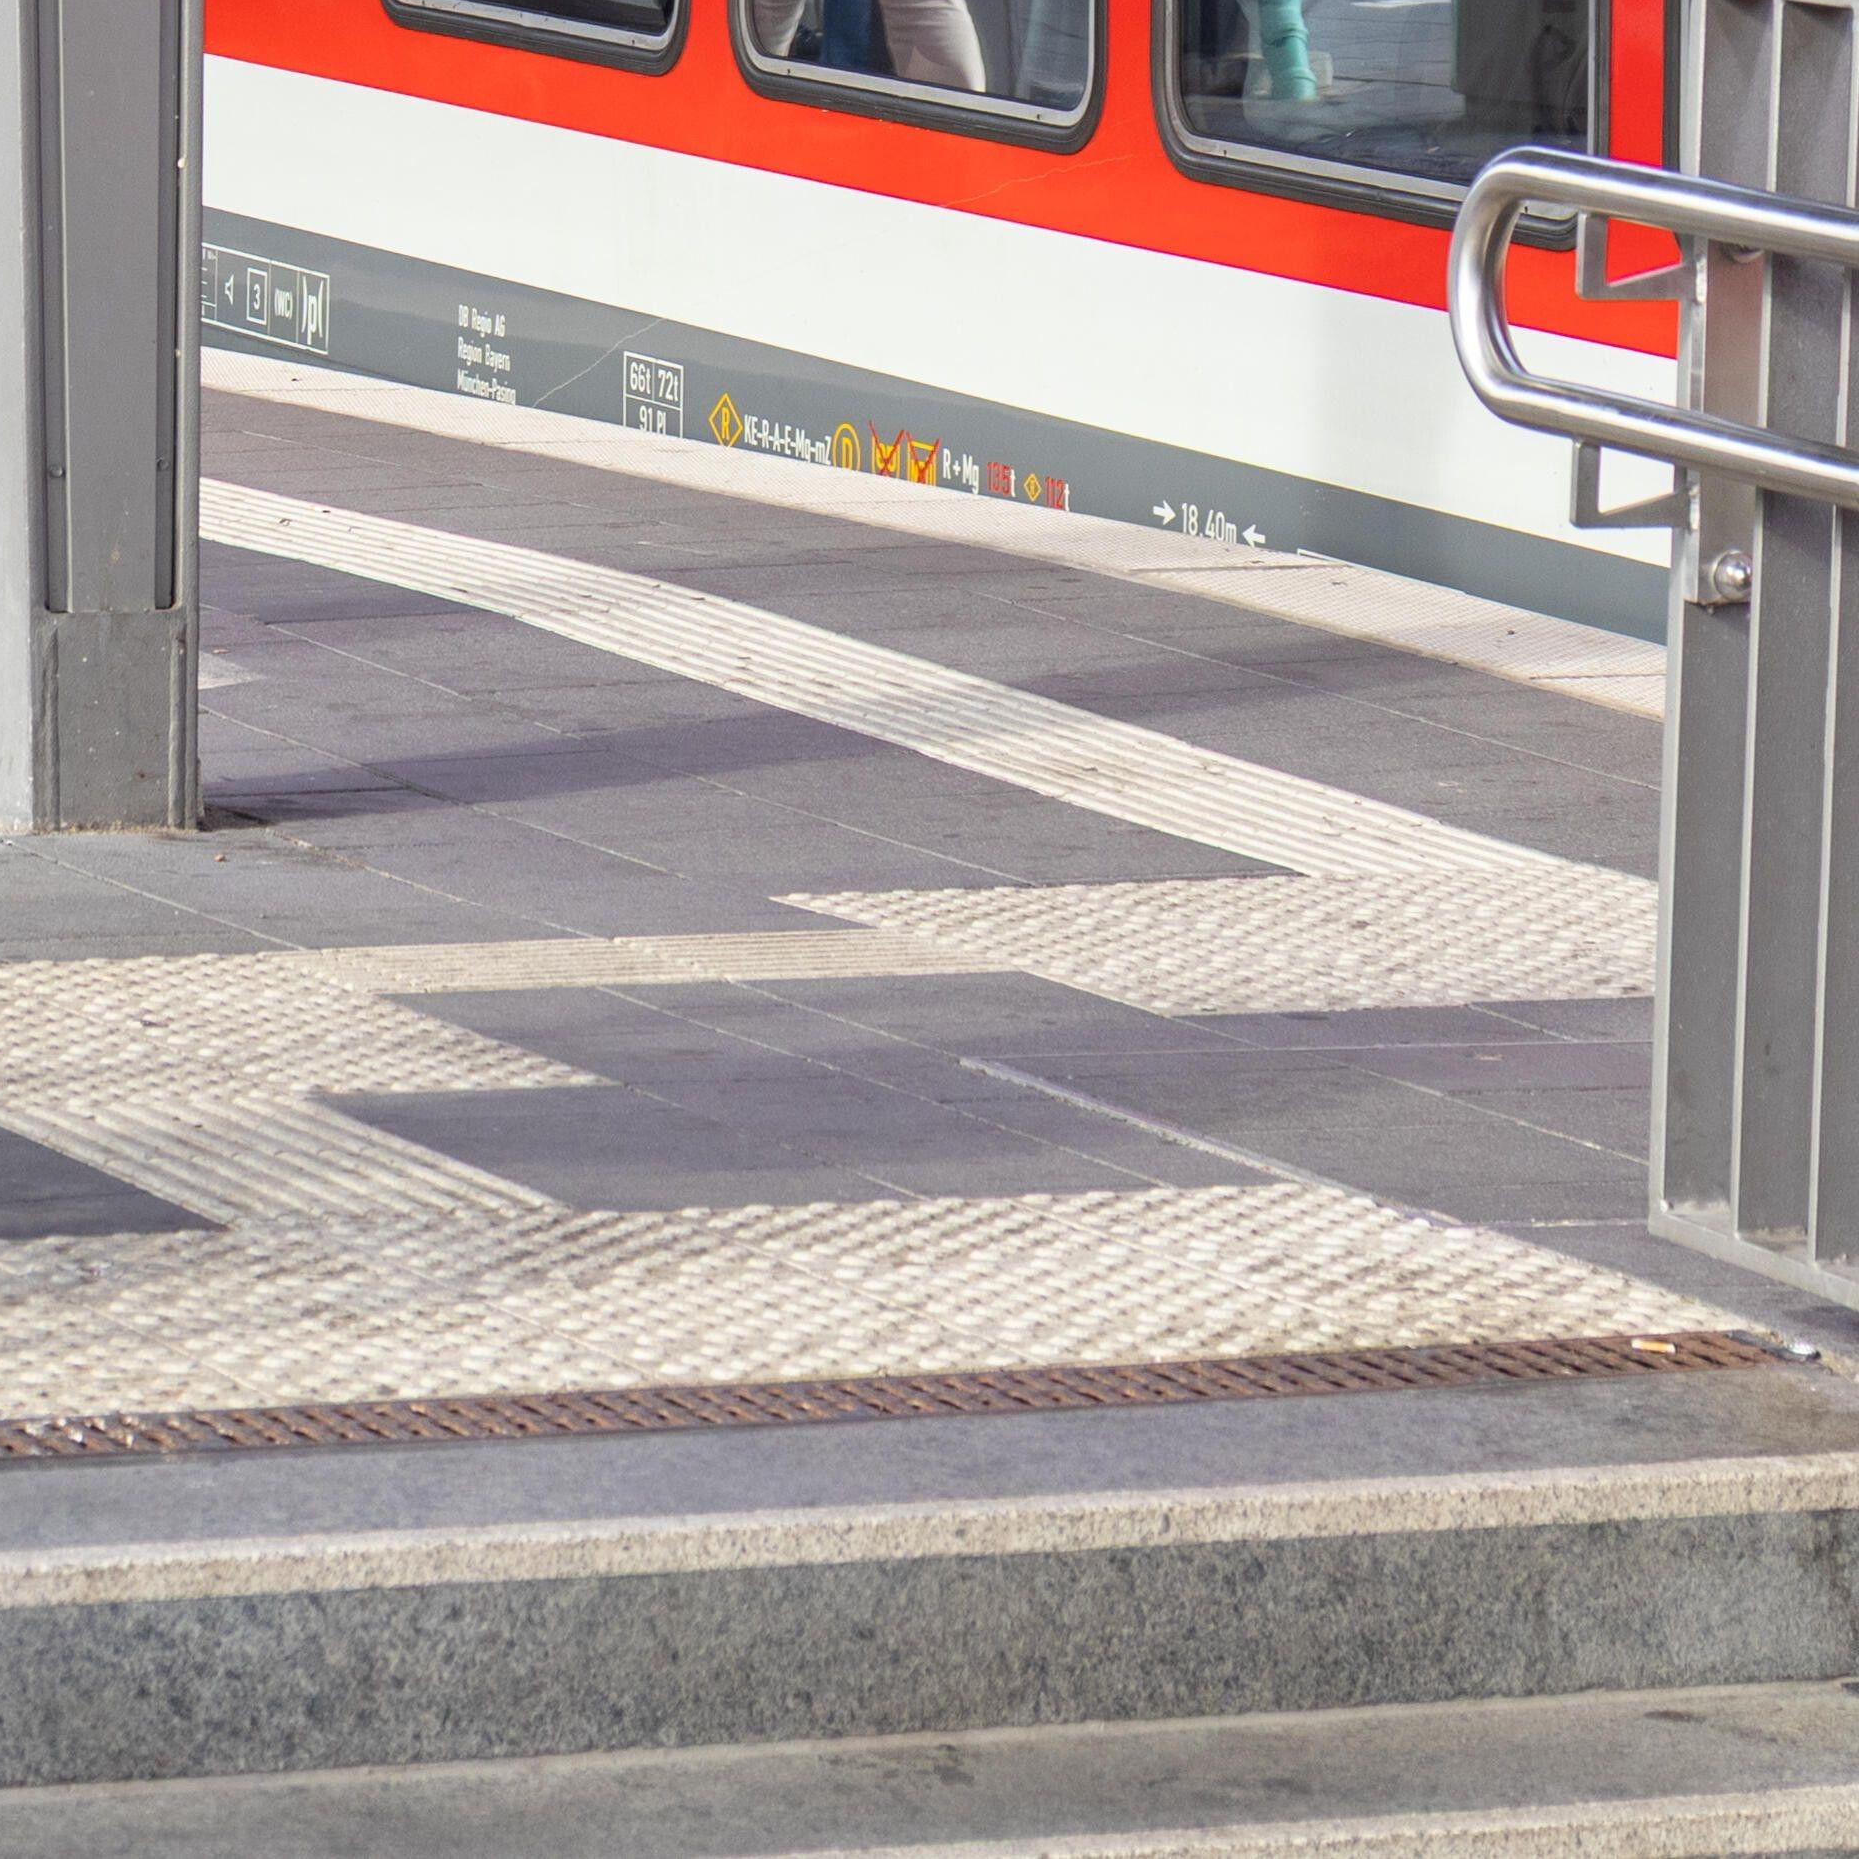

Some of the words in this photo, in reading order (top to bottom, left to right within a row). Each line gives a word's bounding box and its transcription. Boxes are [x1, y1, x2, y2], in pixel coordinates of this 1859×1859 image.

[253, 283, 261, 311] 3
[458, 304, 469, 328] DB
[471, 307, 493, 338] Regio
[494, 313, 506, 338] AG
[458, 336, 483, 367] Region
[485, 343, 511, 373] Bayern
[629, 361, 651, 395] 66t
[657, 368, 679, 402] 72t
[638, 404, 653, 433] 91
[986, 461, 1016, 498] 135t
